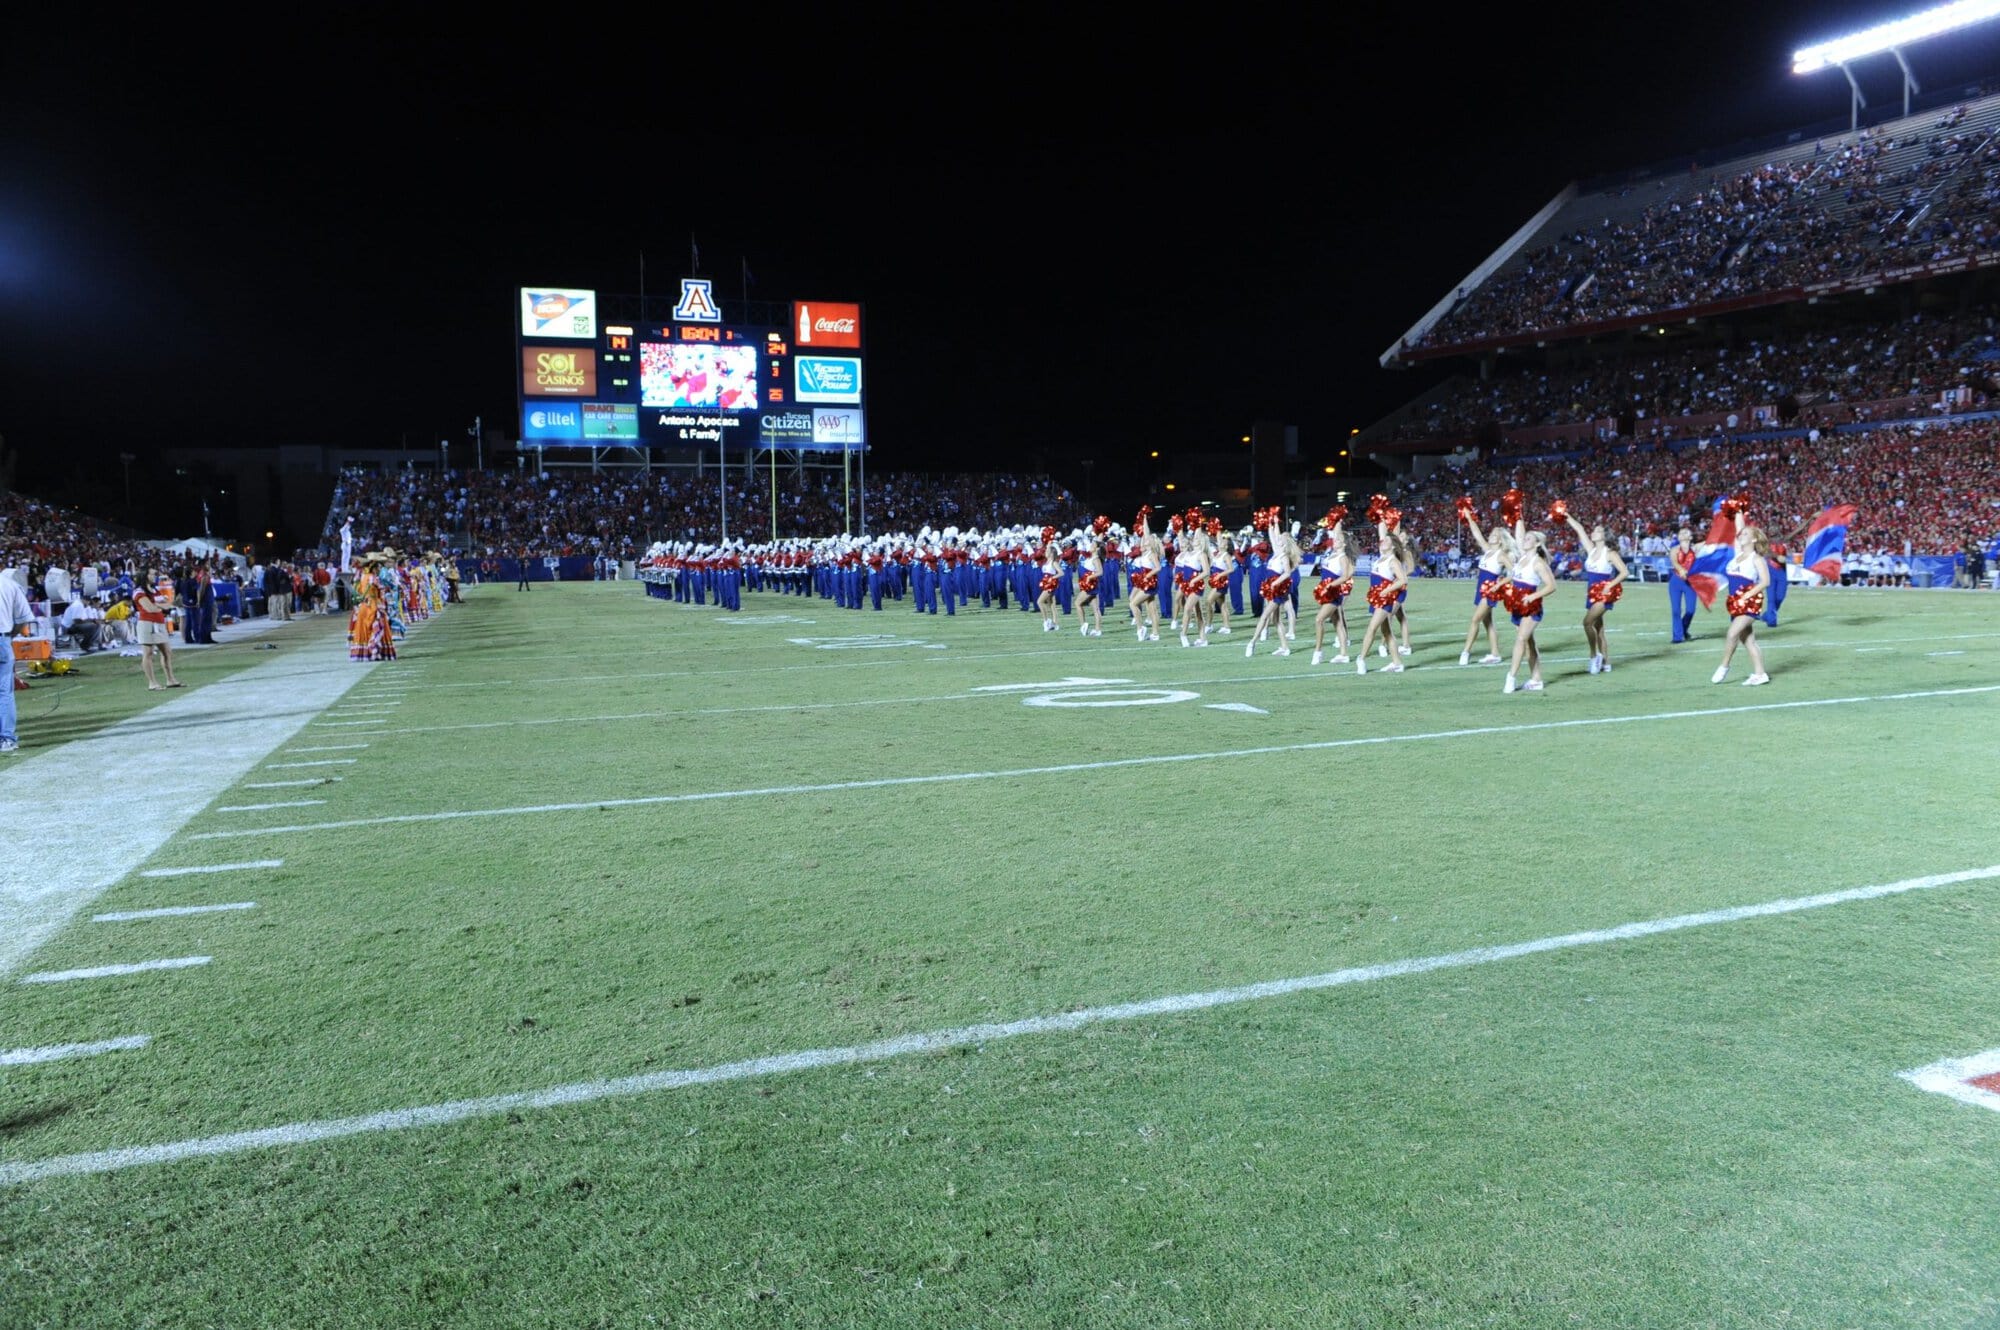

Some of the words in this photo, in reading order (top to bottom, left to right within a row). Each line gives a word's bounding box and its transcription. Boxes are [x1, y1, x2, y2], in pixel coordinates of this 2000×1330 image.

[673, 279, 721, 322] A
[536, 352, 584, 375] SOL
[814, 362, 845, 374] Tucson
[536, 375, 585, 386] CASINOS
[817, 372, 853, 383] Electric
[821, 380, 853, 390] Power
[530, 411, 576, 429] alltel
[659, 414, 696, 426] Antonio
[761, 415, 812, 429] Citizen
[785, 412, 811, 420] Tucson
[679, 429, 688, 439] &
[689, 429, 720, 442] Family
